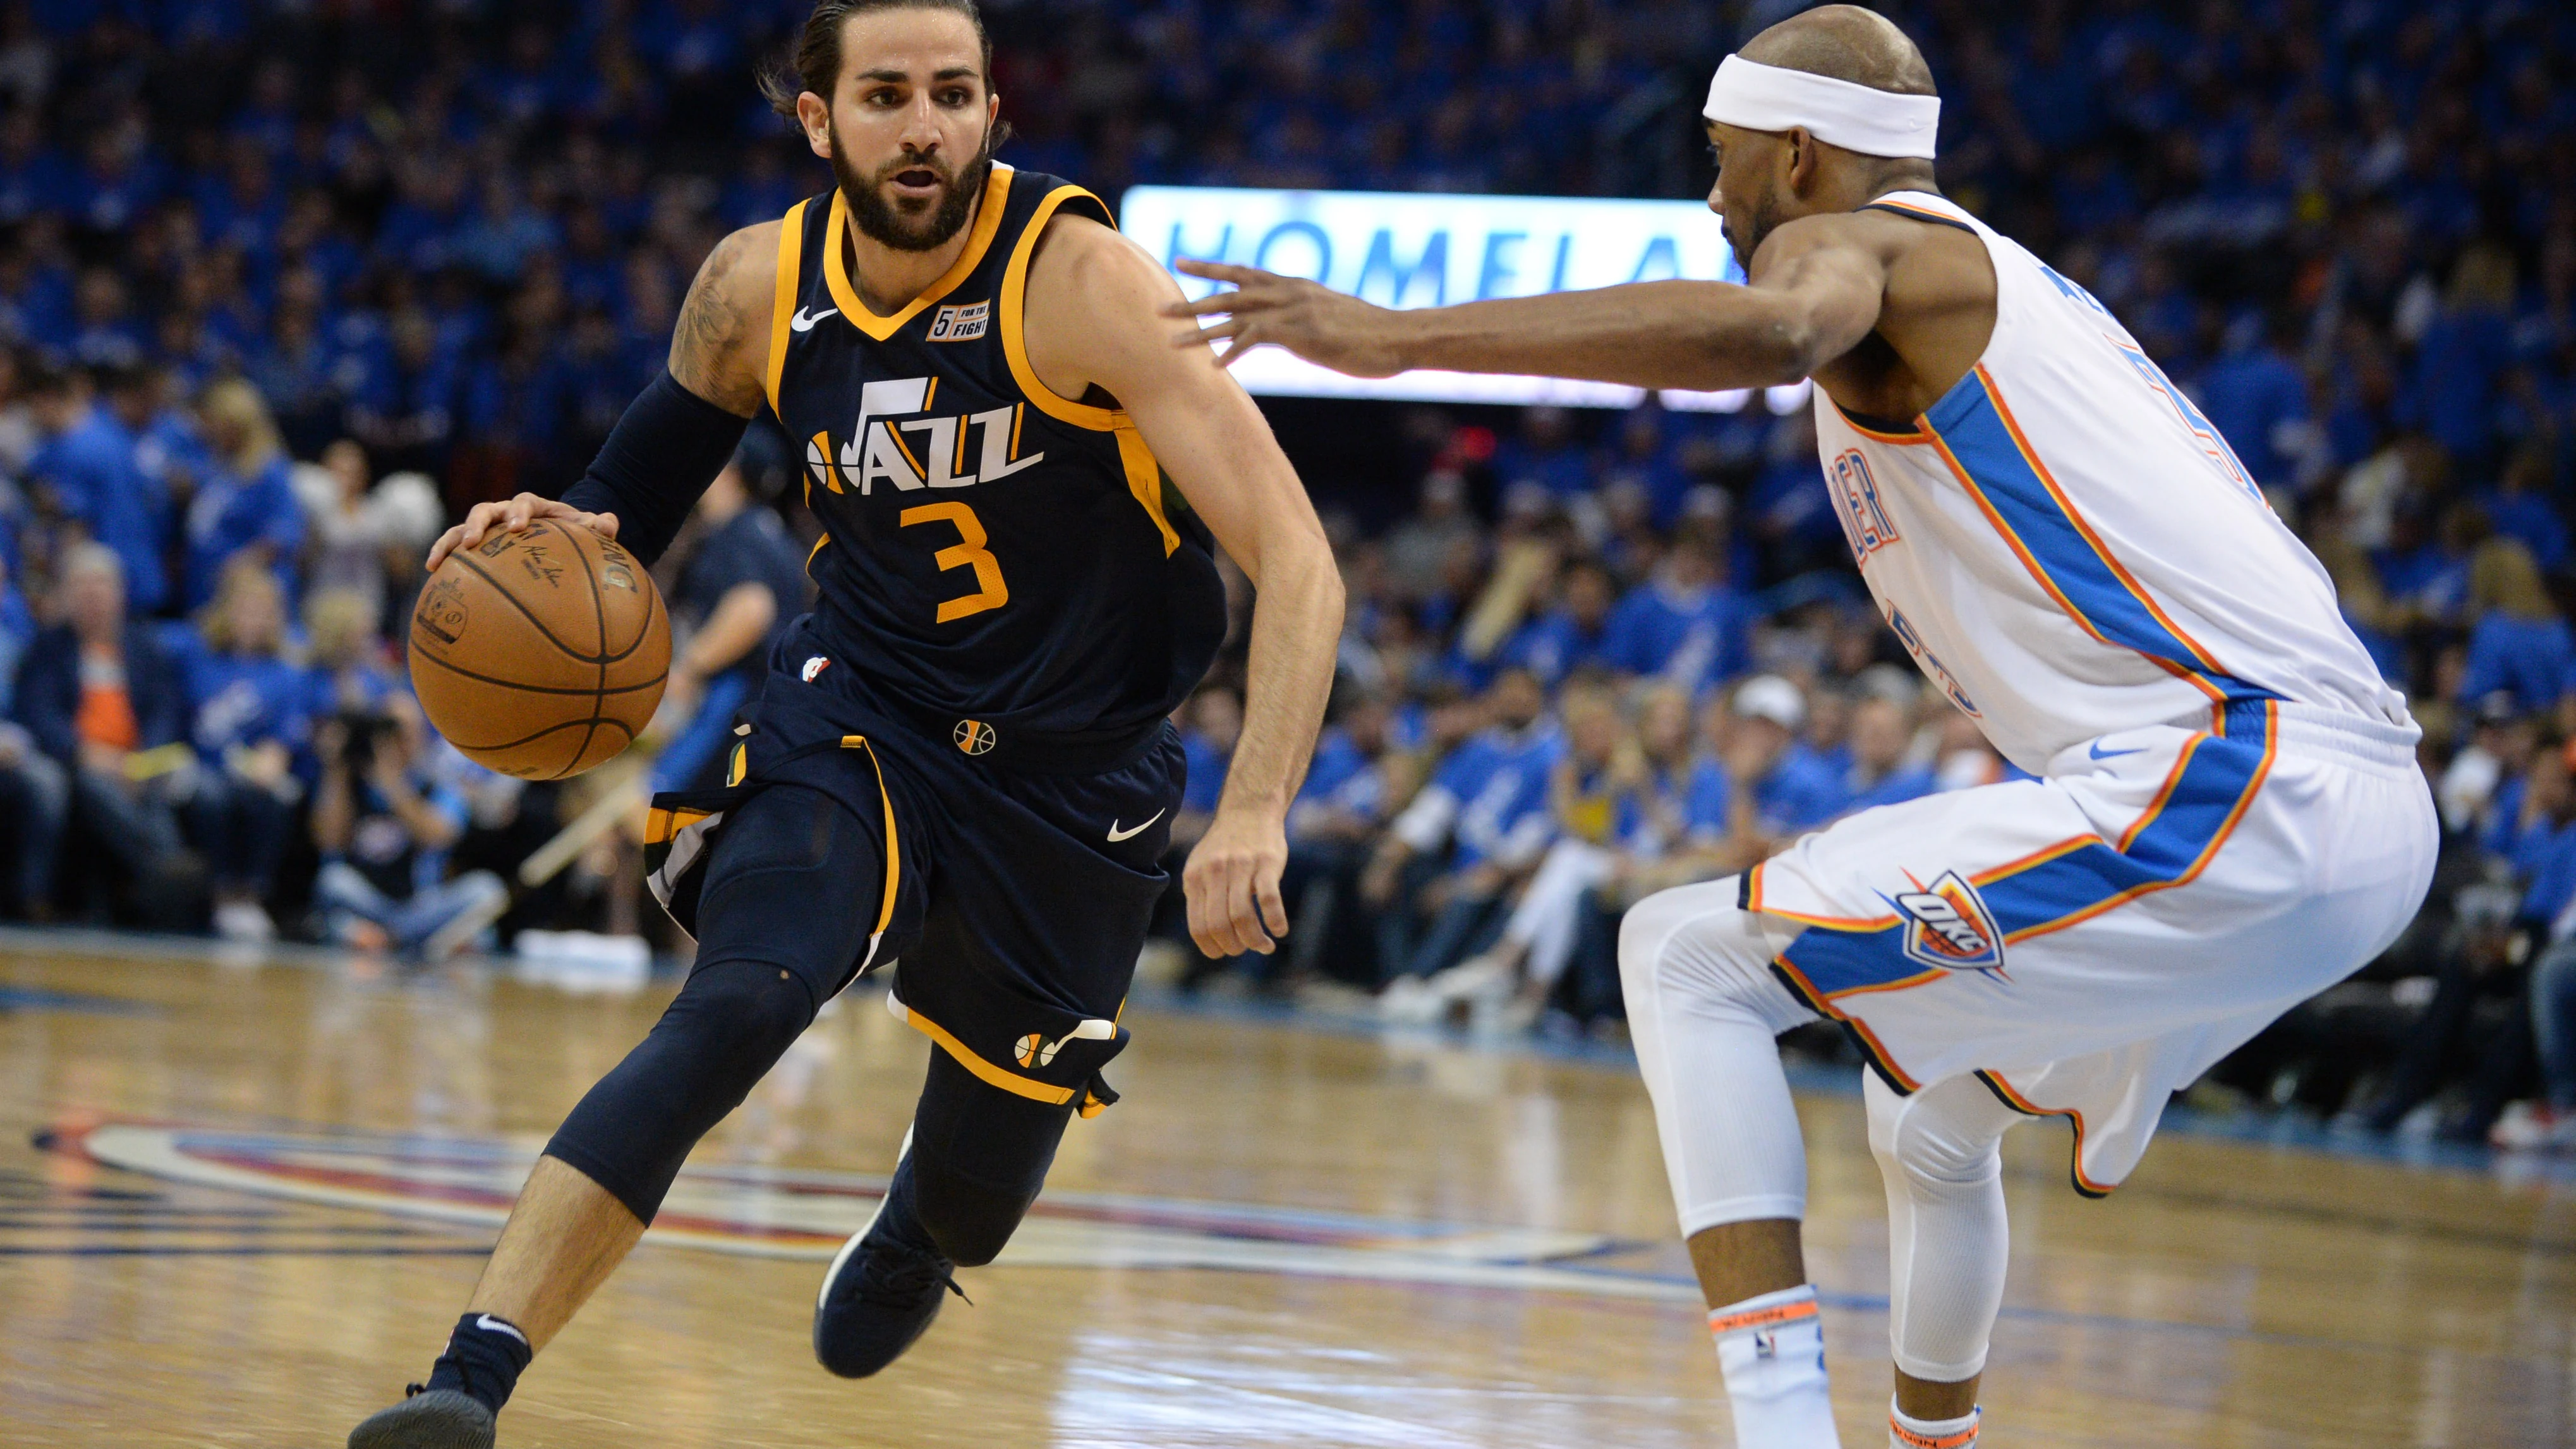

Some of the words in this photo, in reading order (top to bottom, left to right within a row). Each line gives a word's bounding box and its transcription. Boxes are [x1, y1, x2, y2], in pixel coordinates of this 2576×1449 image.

[933, 310, 953, 337] 5
[952, 318, 986, 337] FIGHT
[960, 308, 975, 317] FOR
[976, 305, 987, 315] THE
[807, 377, 1044, 495] JAZZ
[900, 501, 1009, 624] 3
[1896, 892, 1989, 953] OKC
